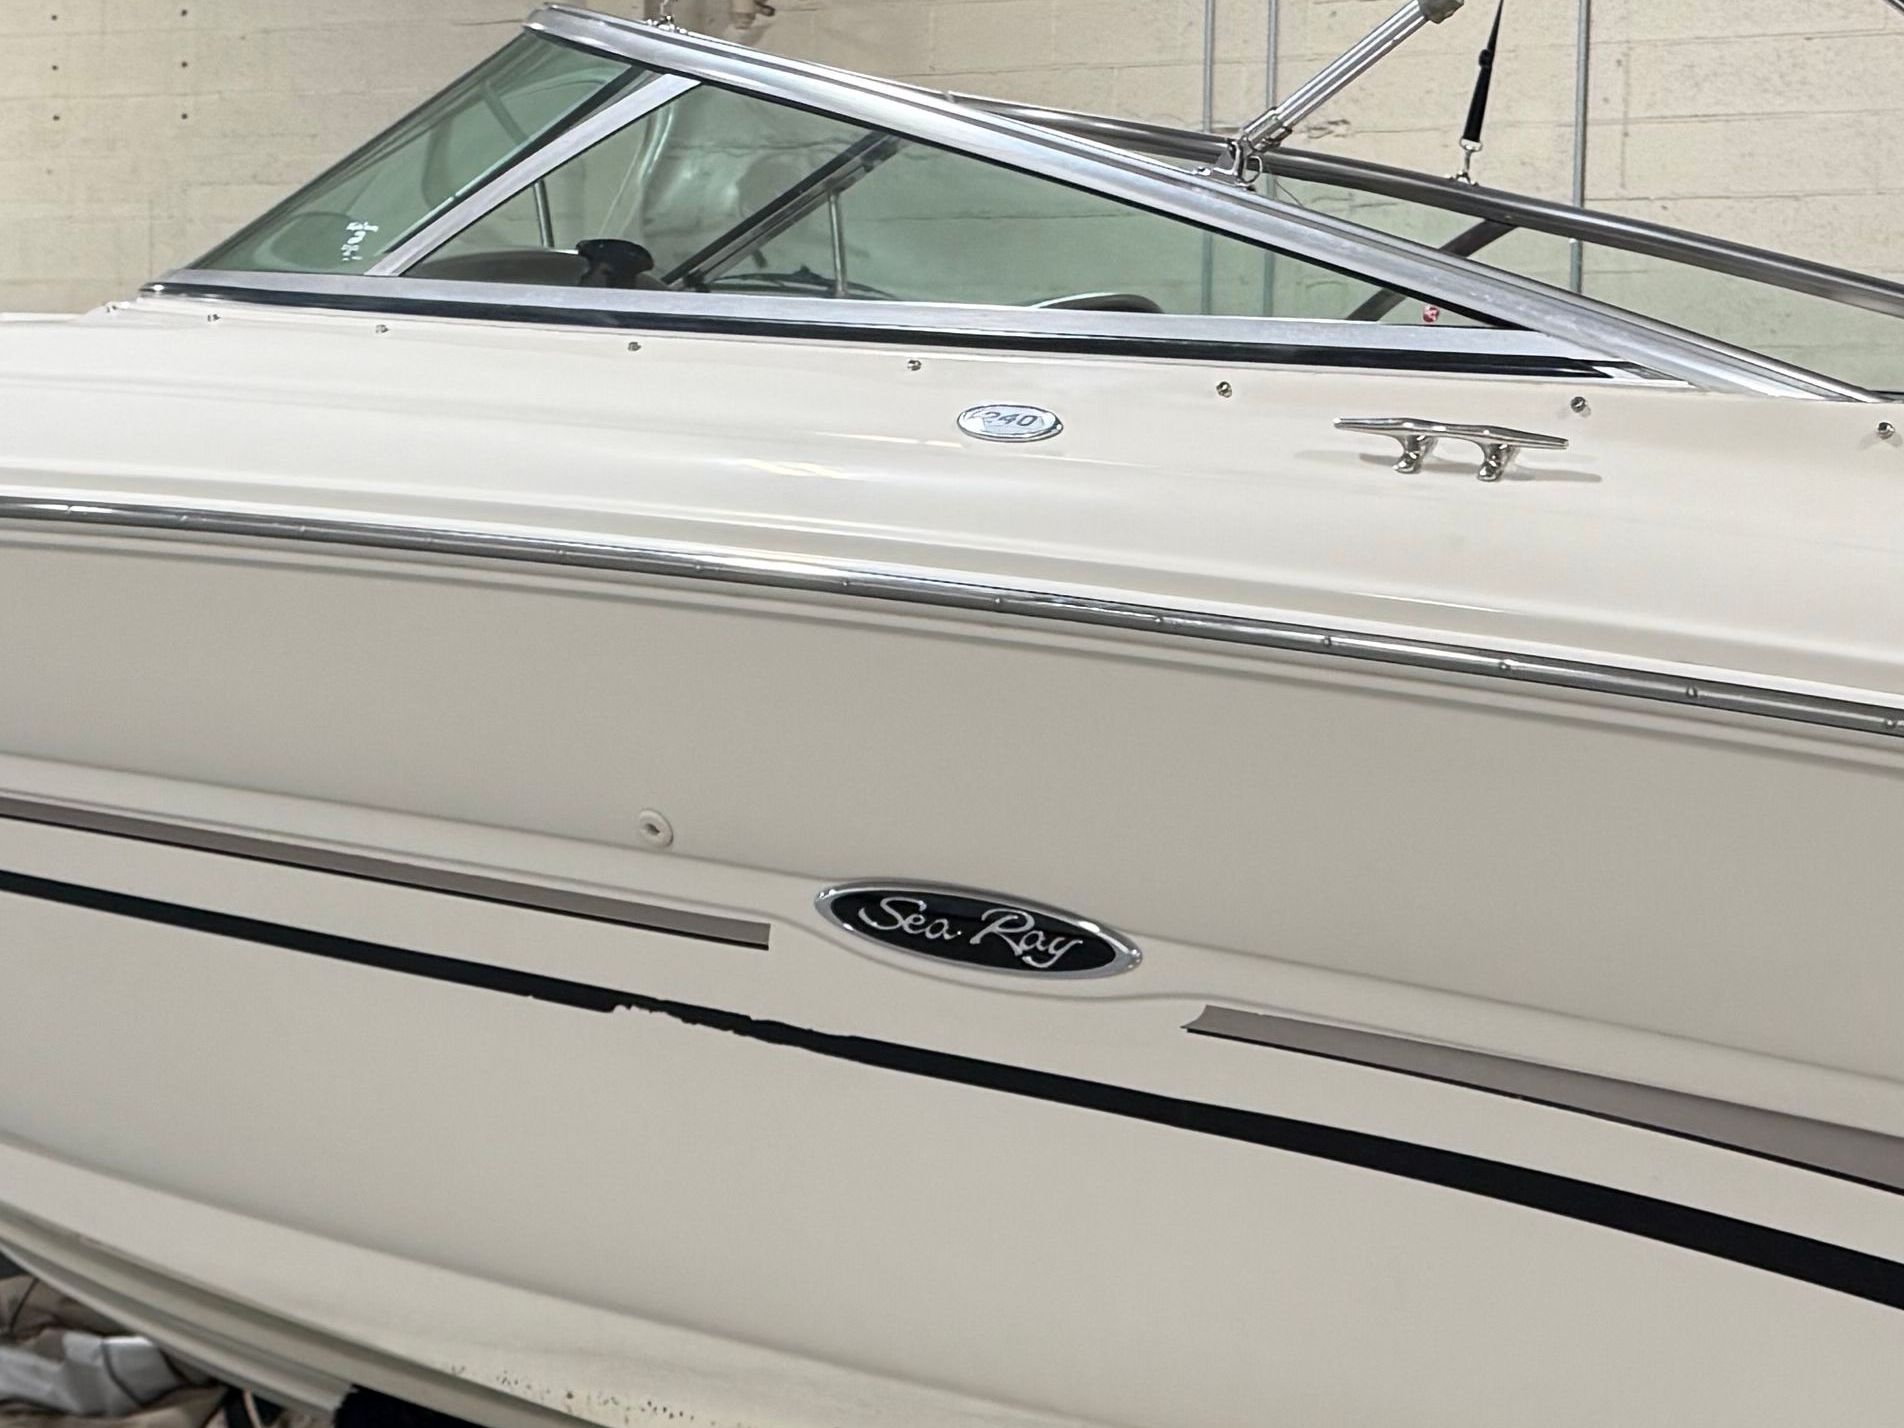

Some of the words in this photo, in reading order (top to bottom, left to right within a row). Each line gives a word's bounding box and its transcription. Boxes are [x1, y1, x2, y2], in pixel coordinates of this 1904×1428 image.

[984, 411, 1038, 427] 240
[858, 896, 962, 940] Sea
[969, 908, 1084, 969] Ray
